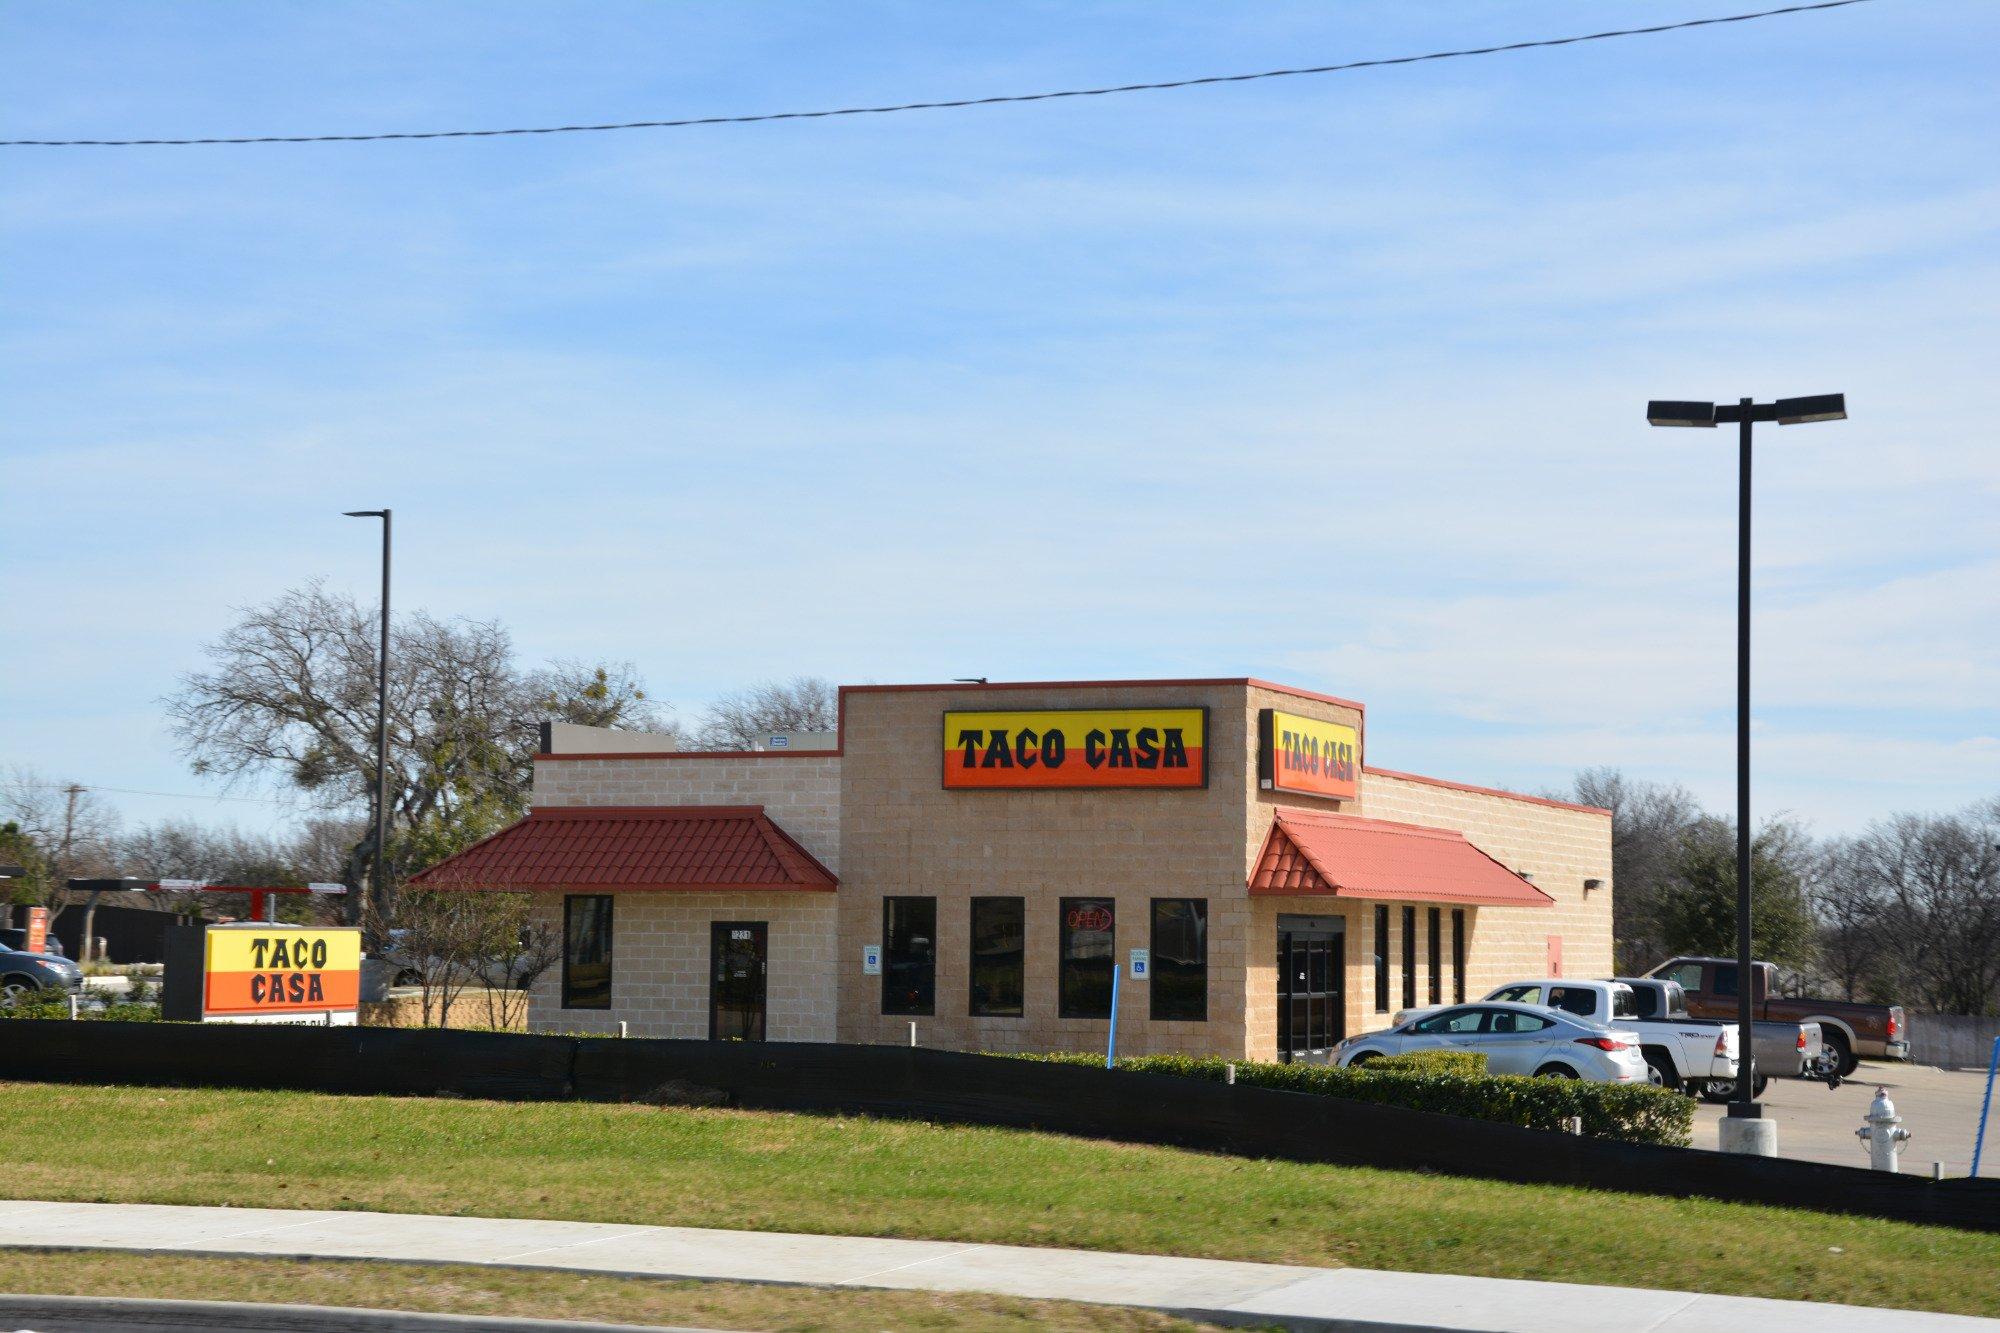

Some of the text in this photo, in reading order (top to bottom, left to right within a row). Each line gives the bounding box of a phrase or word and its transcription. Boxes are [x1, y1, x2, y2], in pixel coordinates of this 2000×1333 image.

[958, 727, 1189, 769] TACO CASA
[1282, 729, 1354, 782] TACO CASA
[1068, 910, 1105, 929] OPEN
[250, 938, 327, 969] TACO
[251, 972, 324, 1004] CASA
